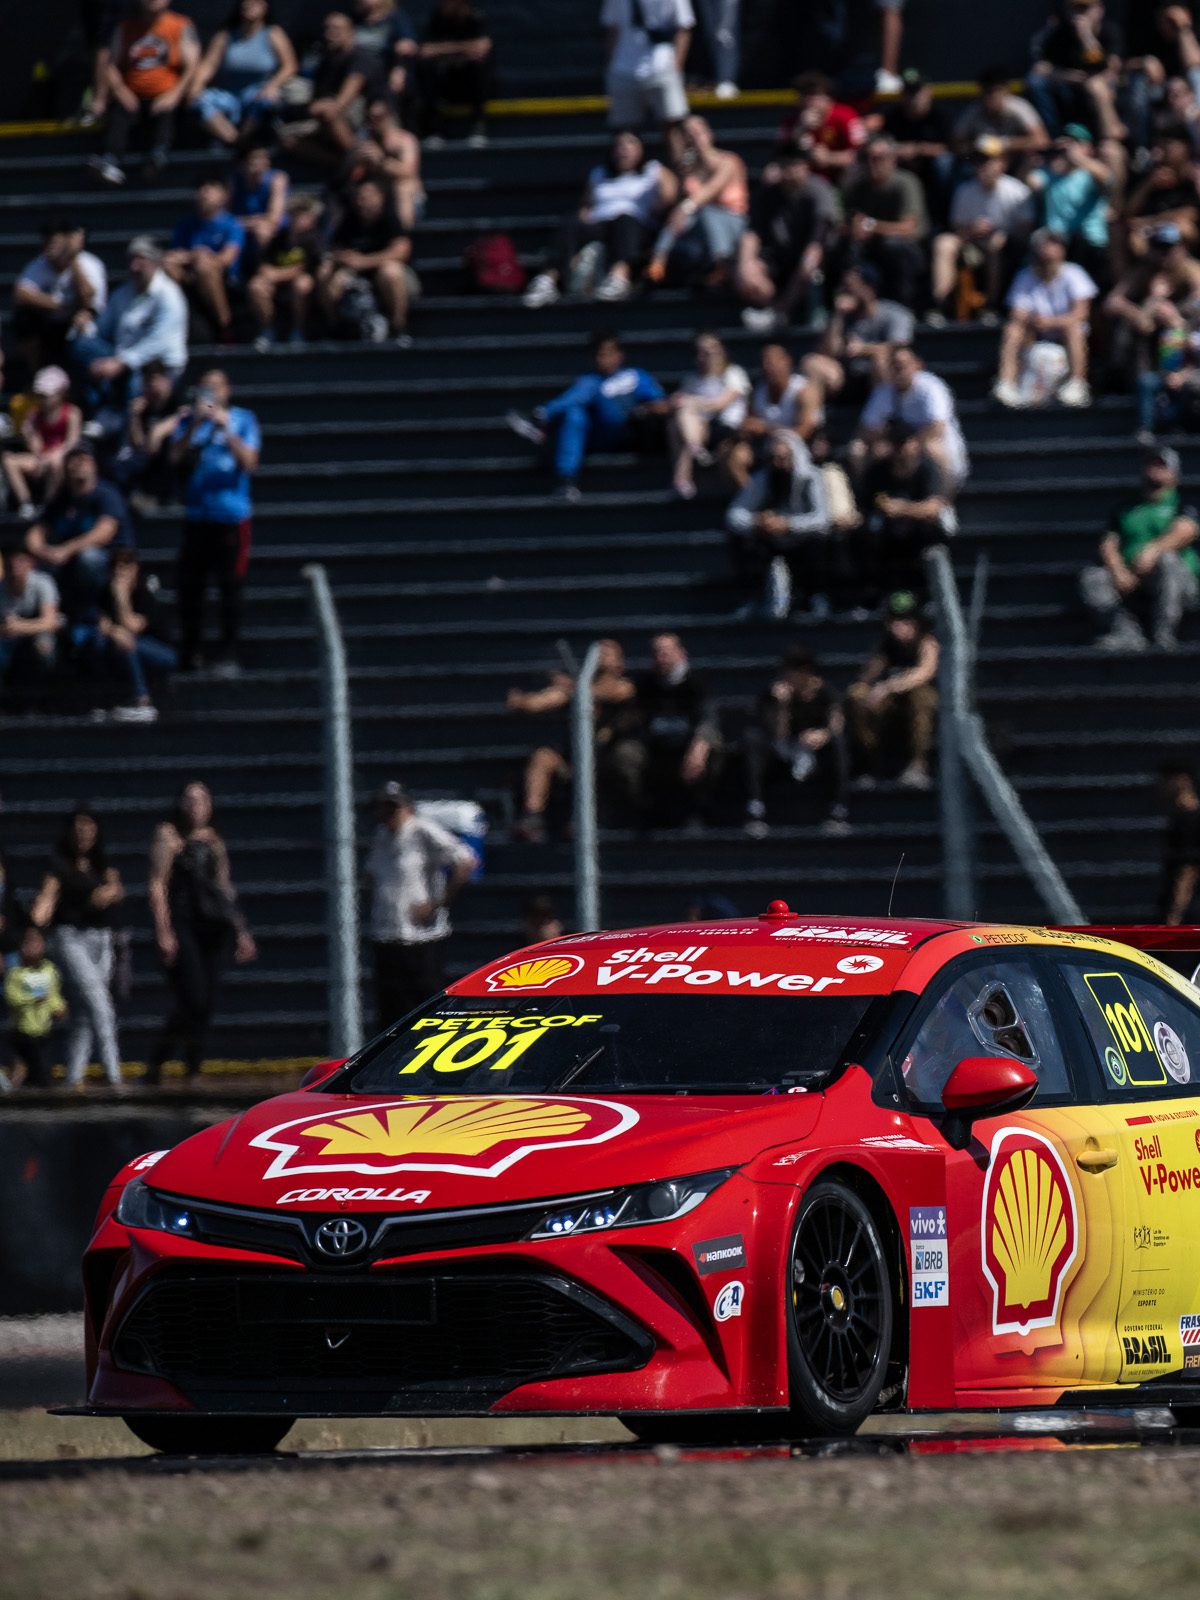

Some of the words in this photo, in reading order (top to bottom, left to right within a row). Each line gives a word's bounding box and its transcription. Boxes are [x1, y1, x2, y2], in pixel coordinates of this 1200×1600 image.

[983, 933, 1029, 944] PETECOF
[603, 946, 709, 964] Shell
[597, 964, 845, 992] V-Power
[410, 1014, 603, 1031] PETECOF
[1105, 1002, 1153, 1052] 101
[398, 1027, 550, 1075] 101
[1134, 1135, 1162, 1161] Shell
[276, 1187, 432, 1204] COROLLA
[911, 1212, 936, 1234] vivo
[924, 1251, 943, 1270] BRB
[914, 1281, 946, 1300] SKF
